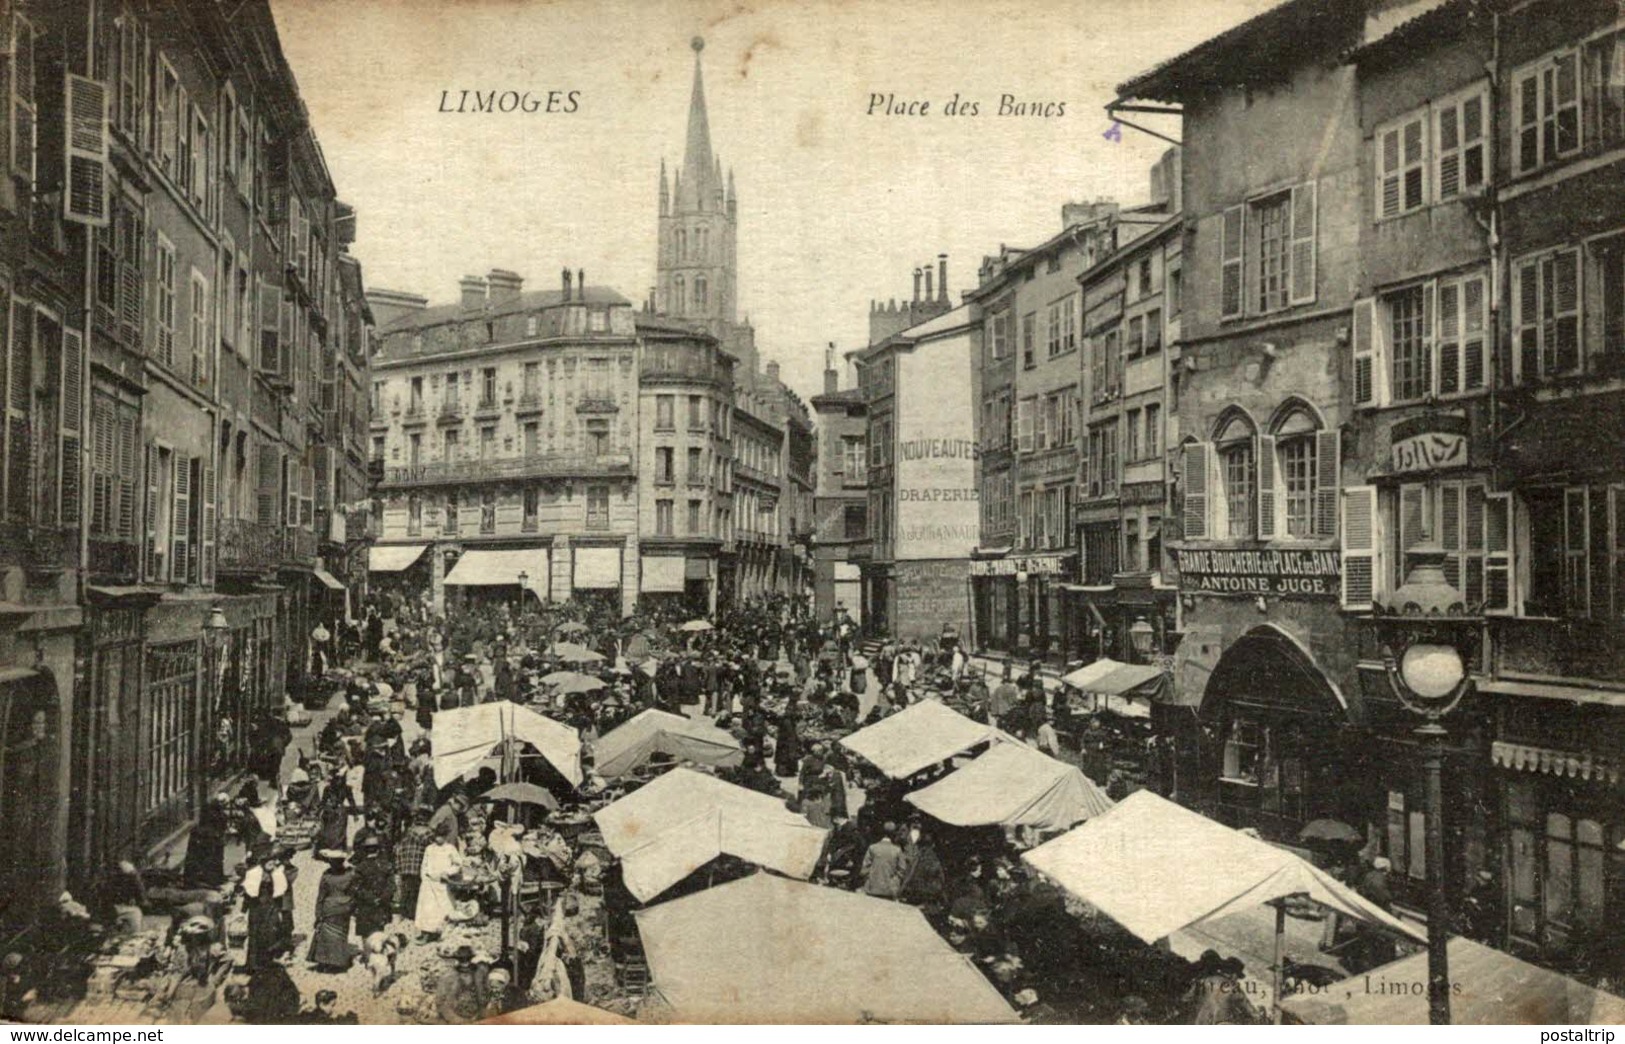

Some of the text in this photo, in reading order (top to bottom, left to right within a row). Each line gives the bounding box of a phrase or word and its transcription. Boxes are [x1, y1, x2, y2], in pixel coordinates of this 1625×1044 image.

[900, 438, 980, 462] NOUVEAUTES
[900, 487, 980, 502] DRAPERIE
[1178, 550, 1211, 573] GRANDE
[1211, 550, 1262, 574] BOUCHERIE
[1272, 550, 1303, 575] PLACE
[1200, 576, 1270, 592] ANTOINE
[1277, 578, 1326, 594] JUGE
